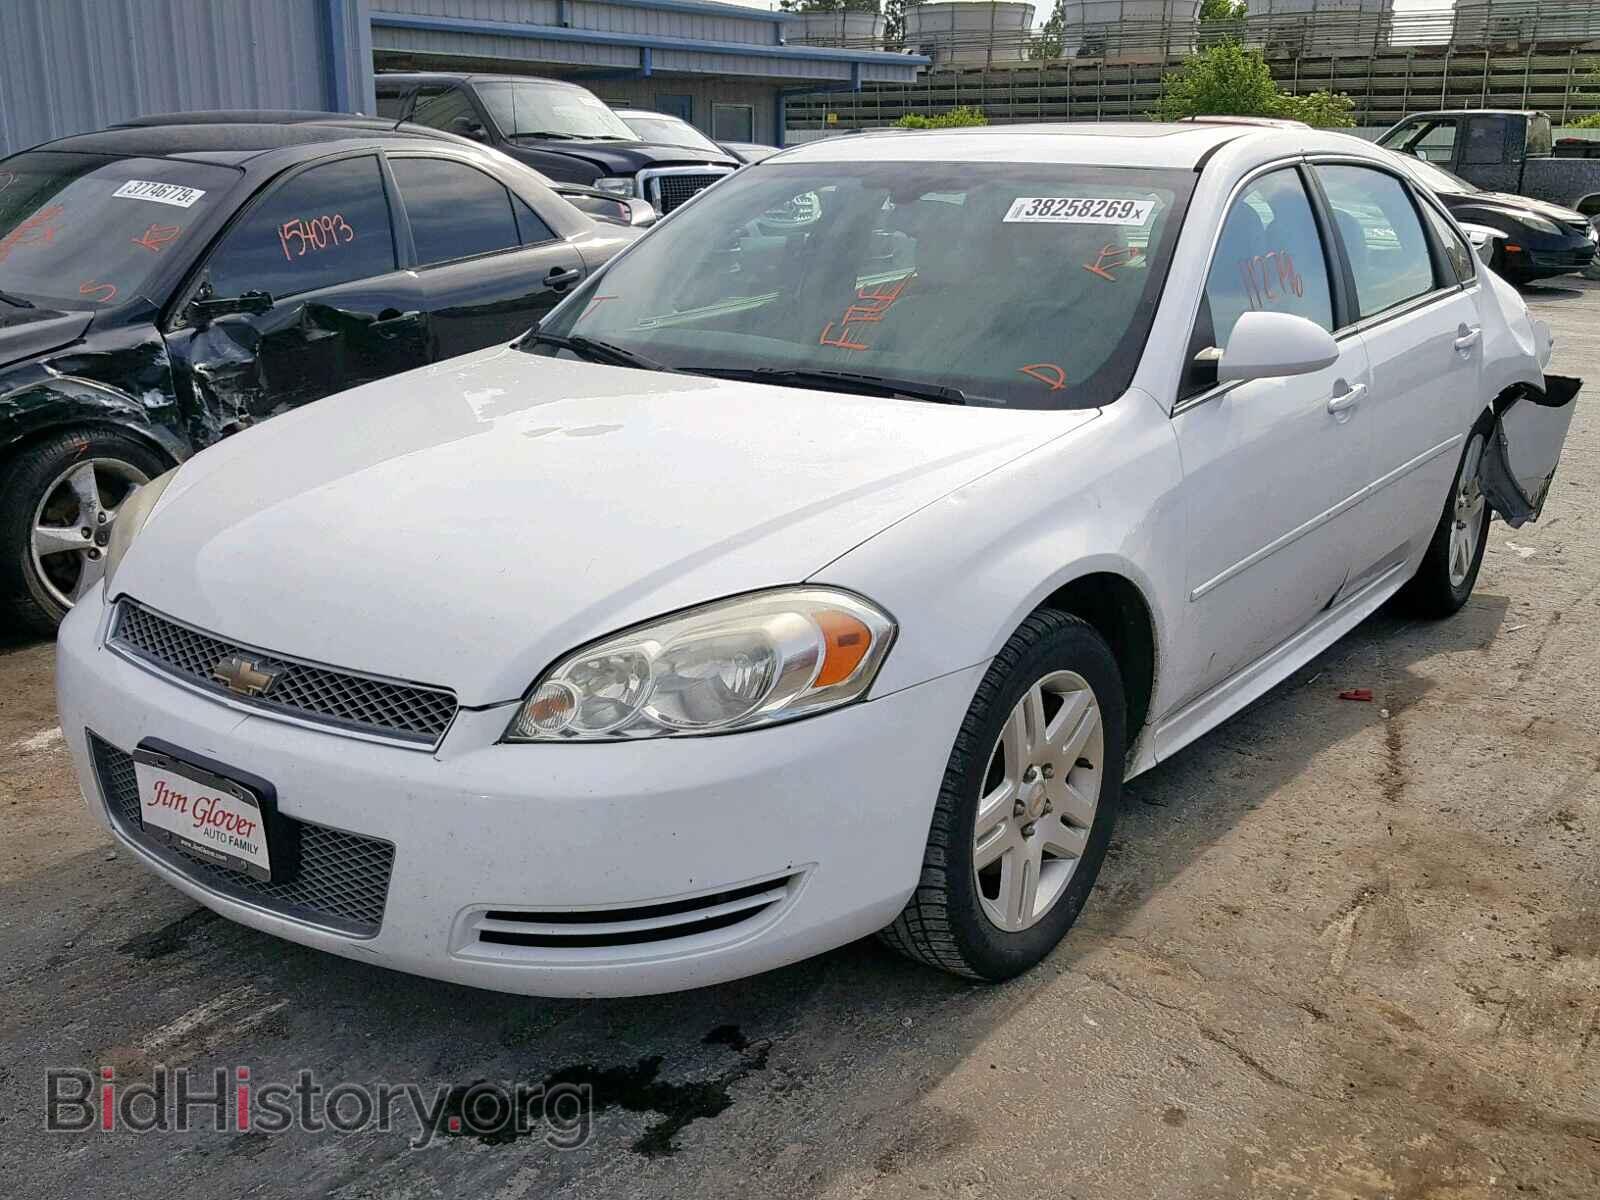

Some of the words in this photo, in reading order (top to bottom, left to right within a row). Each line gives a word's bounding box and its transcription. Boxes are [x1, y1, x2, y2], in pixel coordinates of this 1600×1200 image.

[278, 213, 354, 261] 154093
[147, 780, 188, 813] Jim
[192, 796, 256, 838] Glover
[203, 827, 227, 844] AUTO
[228, 835, 259, 855] FAMILY
